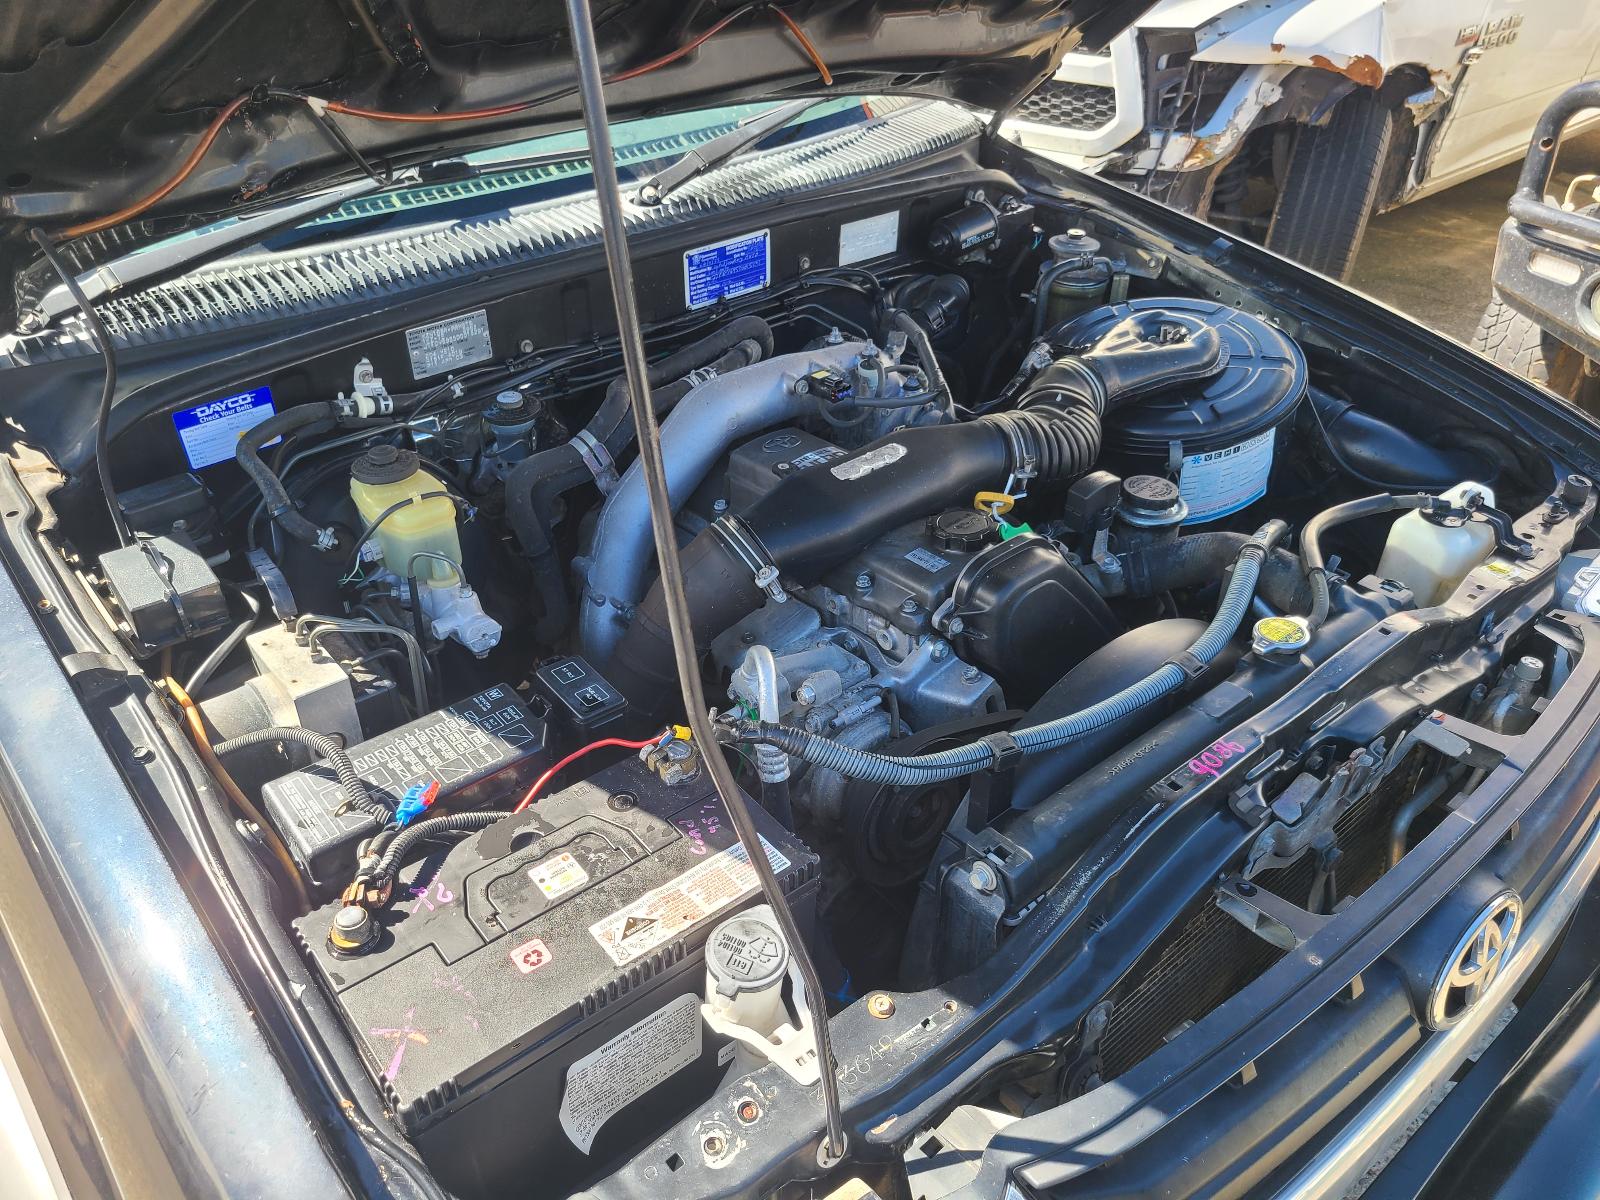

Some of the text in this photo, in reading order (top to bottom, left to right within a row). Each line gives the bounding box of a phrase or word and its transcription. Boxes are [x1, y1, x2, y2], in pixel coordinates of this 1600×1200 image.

[1485, 15, 1524, 36] RAM
[194, 394, 254, 416] DAYCO
[199, 403, 252, 423] Check Your Belts
[599, 1009, 667, 1054] Warranty Information
